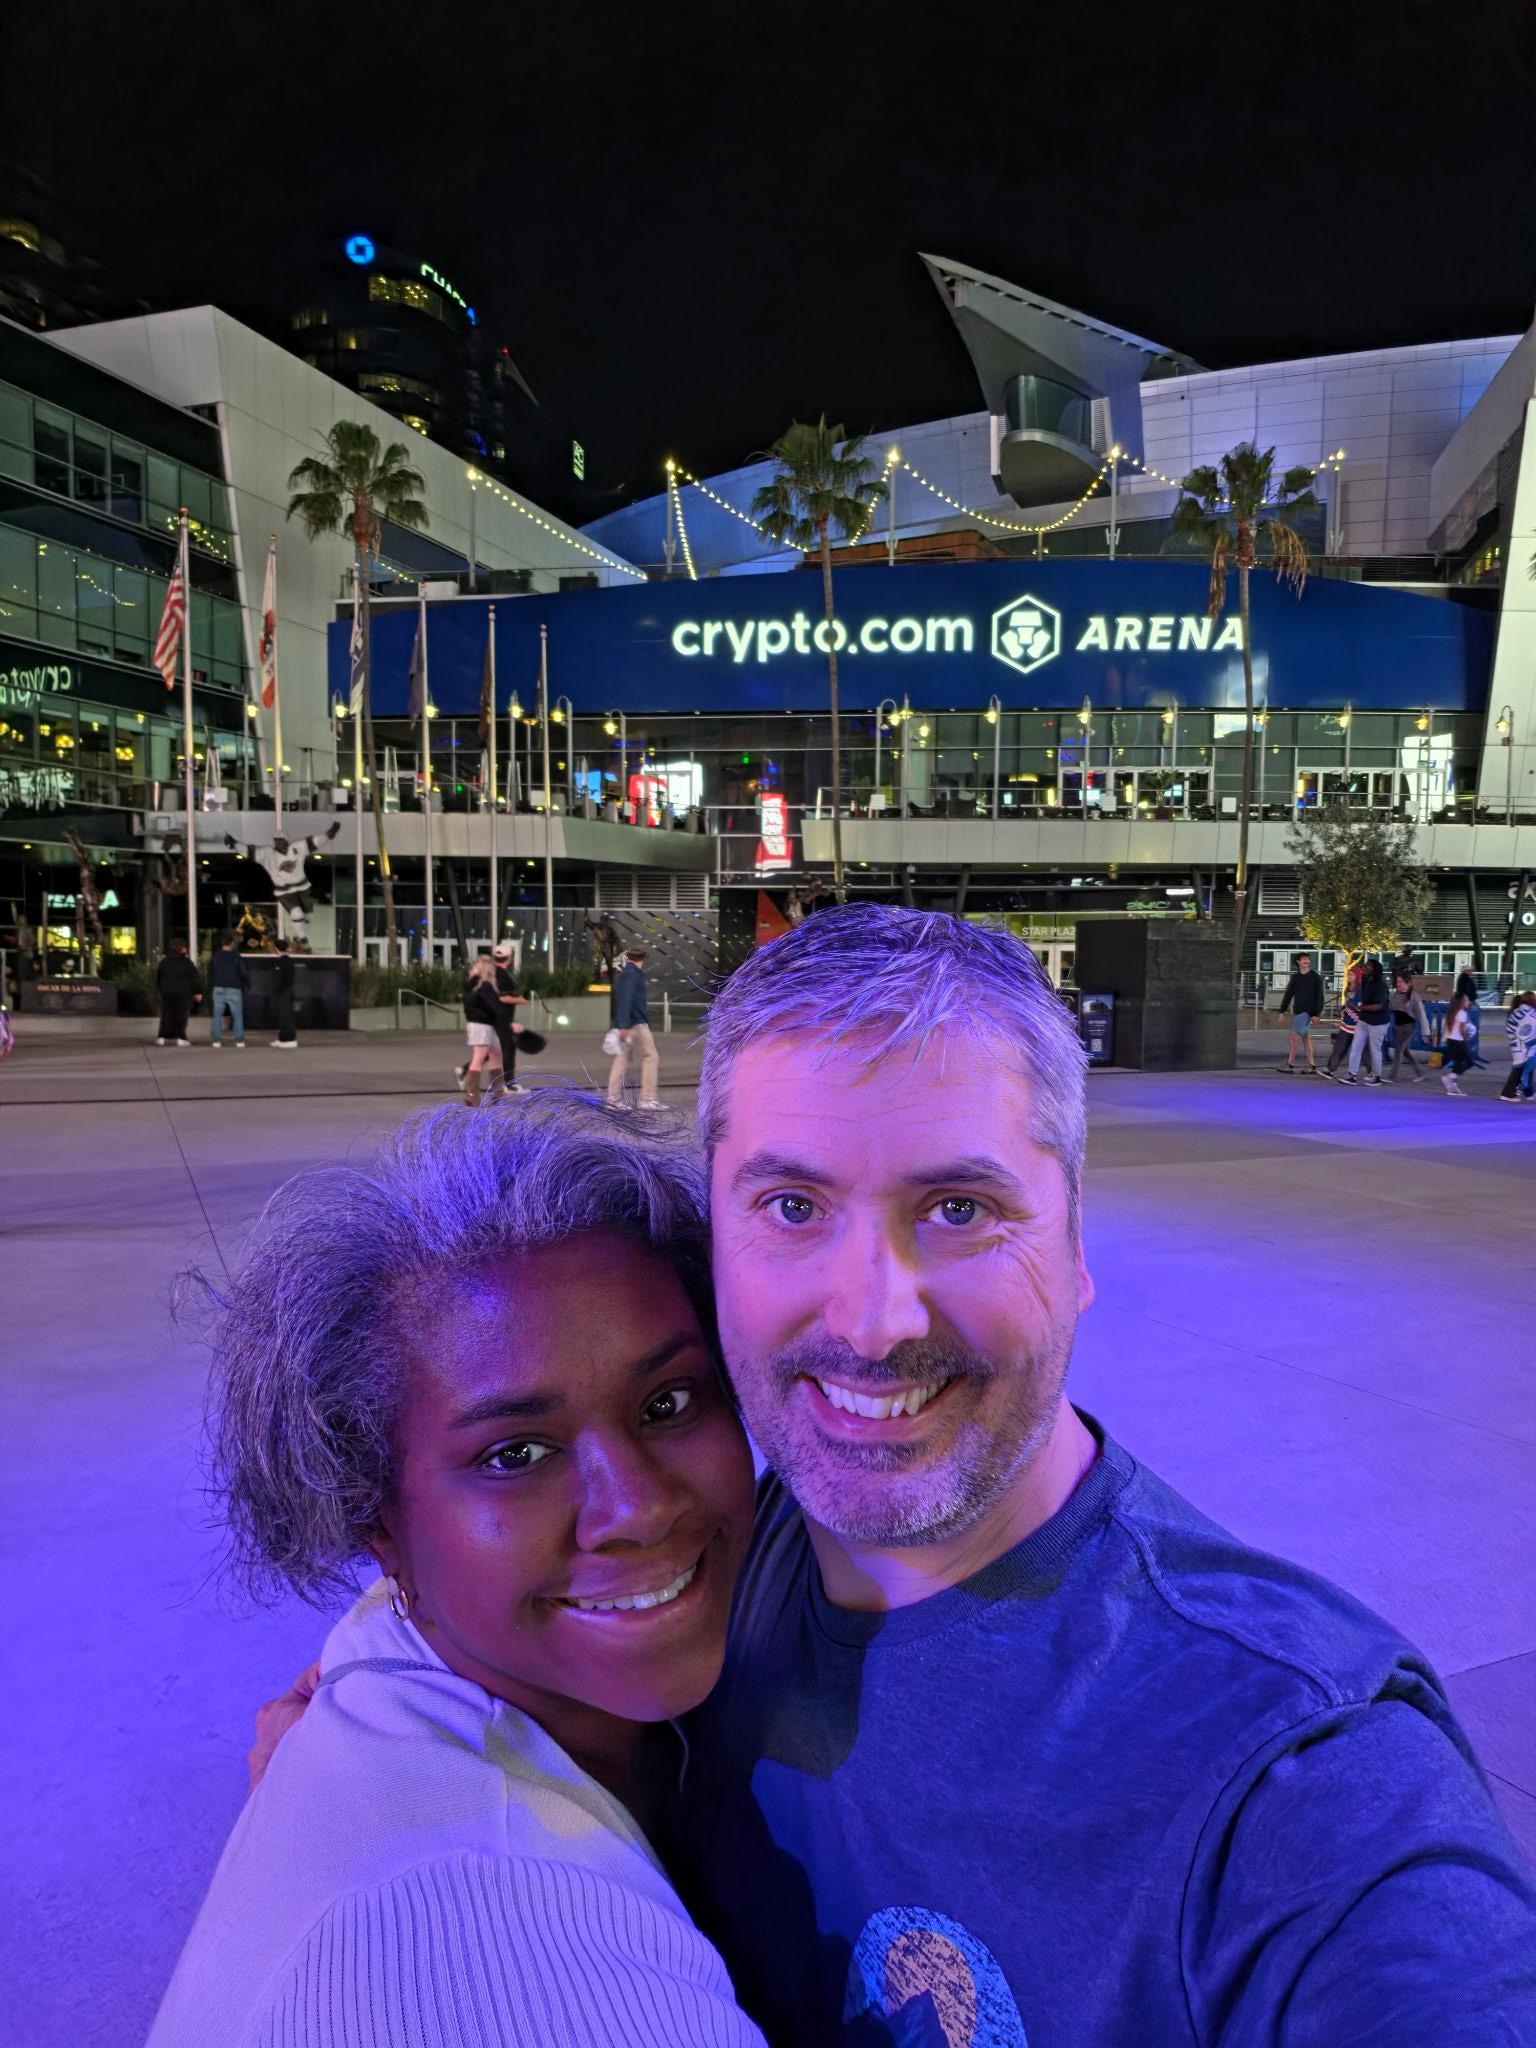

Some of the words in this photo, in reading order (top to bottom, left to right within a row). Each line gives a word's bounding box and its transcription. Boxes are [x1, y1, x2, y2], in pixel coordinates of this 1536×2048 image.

[672, 612, 974, 663] crypto.com
[1075, 616, 1244, 651] ARENA
[1021, 926, 1049, 936] STAR
[1050, 926, 1075, 936] PLAZ
